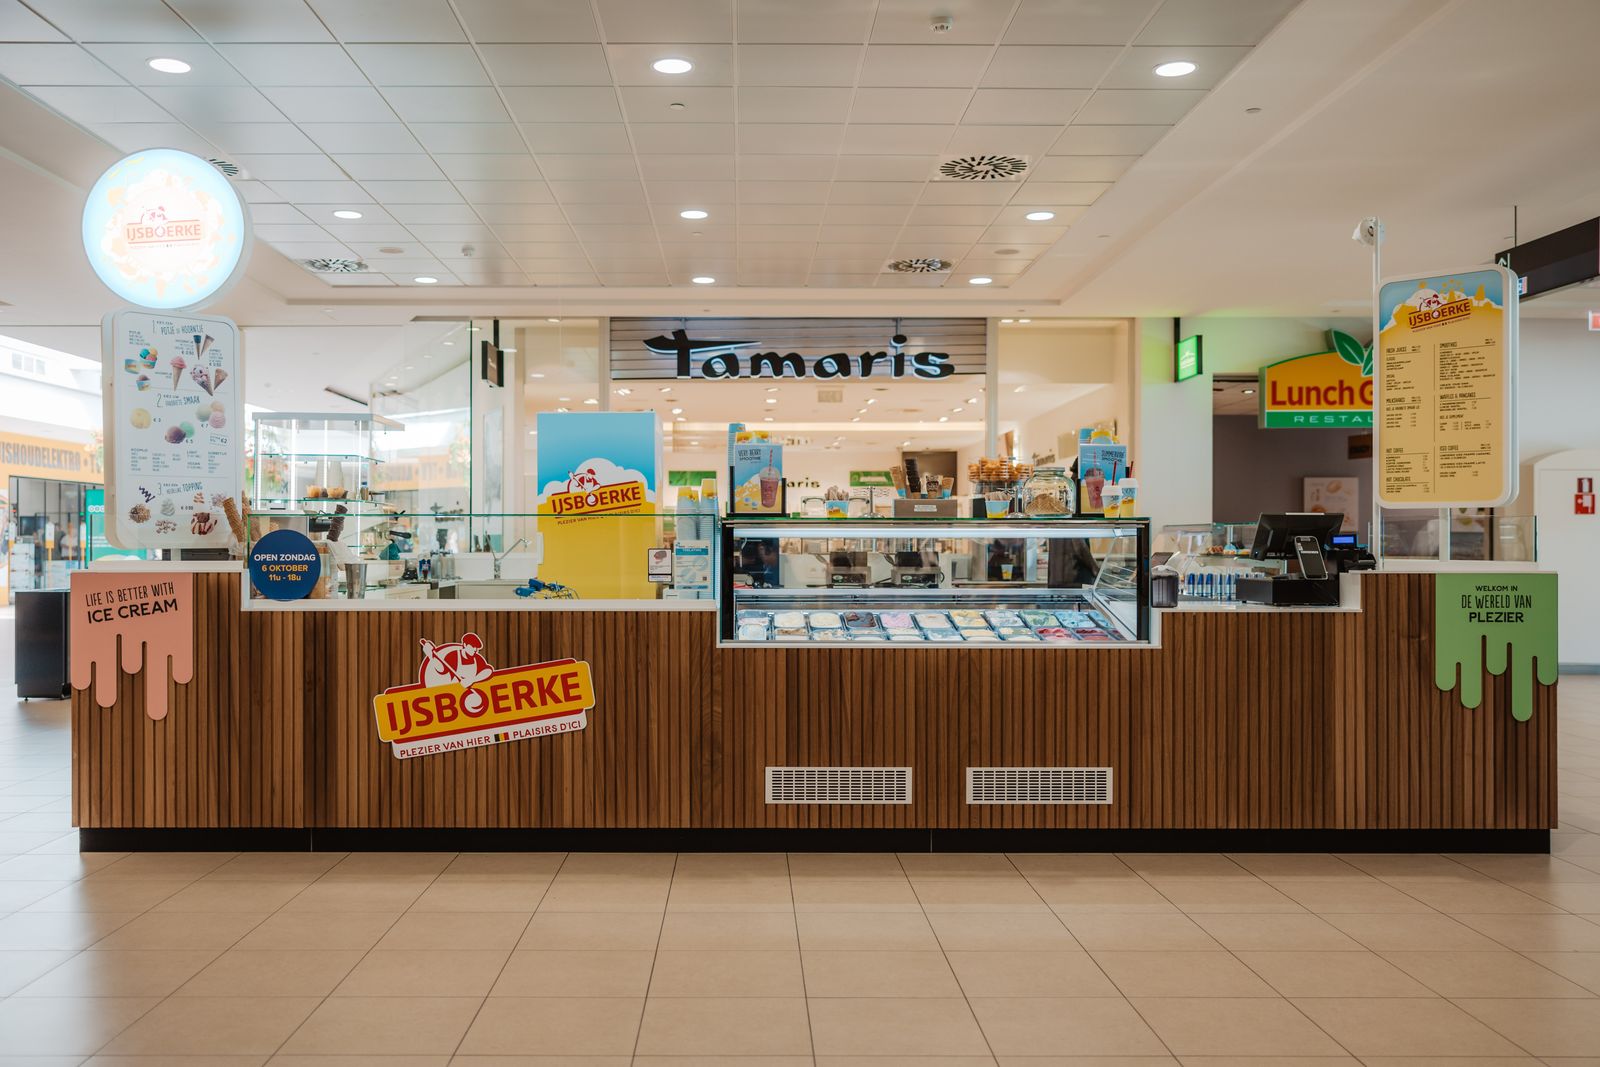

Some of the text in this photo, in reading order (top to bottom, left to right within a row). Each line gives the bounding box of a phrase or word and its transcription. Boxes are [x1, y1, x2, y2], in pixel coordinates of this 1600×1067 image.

[126, 224, 201, 242] IJSBOERKE
[1409, 302, 1471, 326] IJSBOERKE
[182, 325, 204, 334] HOORNTJE
[643, 329, 954, 379] Tamaris
[184, 396, 200, 405] SMAAK
[1271, 380, 1354, 406] Lunch
[552, 486, 641, 514] IJSBOERKE
[261, 564, 308, 572] 6 OKTOBER
[85, 582, 174, 607] LIFE IS BETTER WITH
[1461, 594, 1531, 608] DE WERELD VAN
[87, 598, 178, 624] ICE CREAM
[1469, 612, 1524, 622] PLEZIER
[386, 671, 583, 735] IJSBOERKE
[400, 720, 581, 757] PLEZIER VAN HIER PLAISIRS D'ICI
